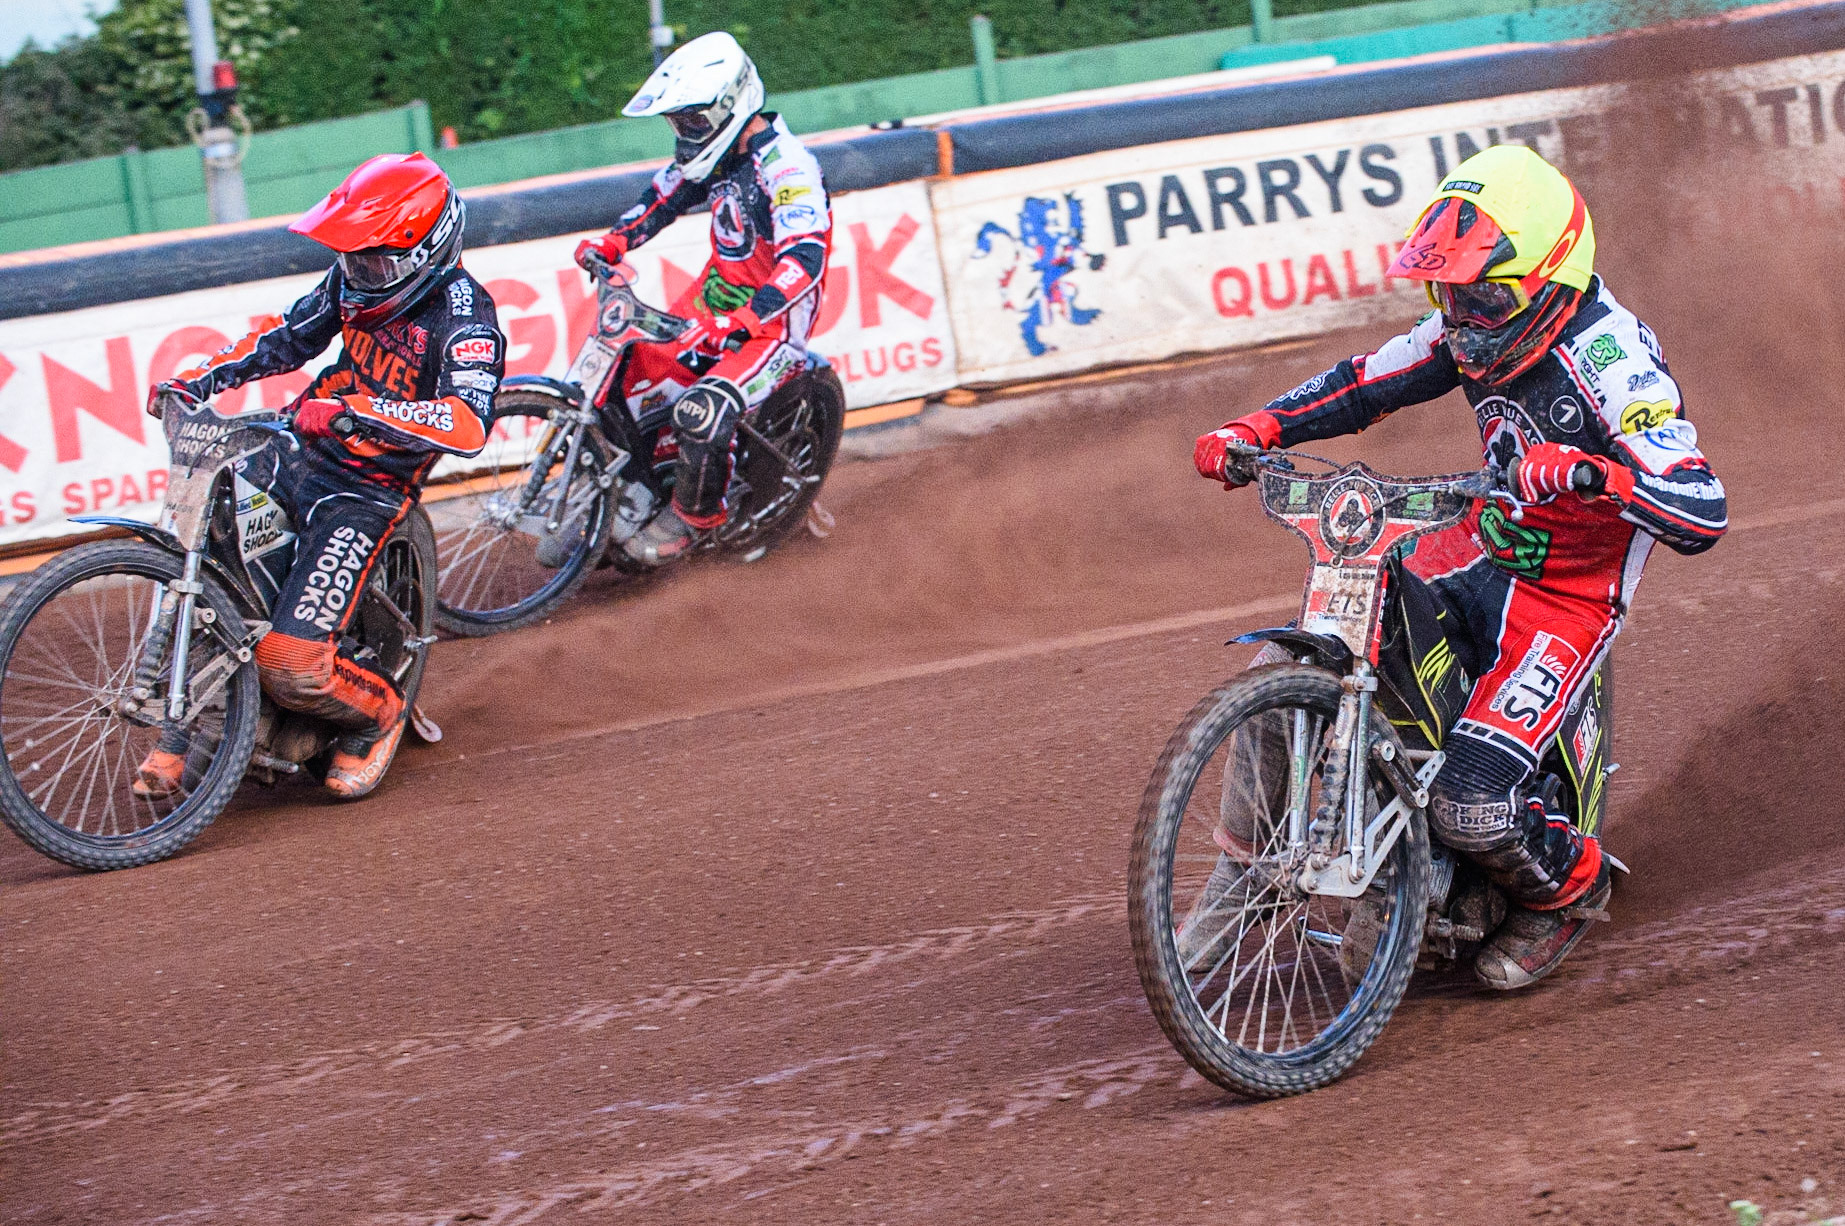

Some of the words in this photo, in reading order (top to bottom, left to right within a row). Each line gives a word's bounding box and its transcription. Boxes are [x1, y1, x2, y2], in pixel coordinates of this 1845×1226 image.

[1105, 143, 1404, 247] PARRYS
[1211, 241, 1421, 318] QUALI
[455, 341, 494, 358] NGK
[372, 402, 455, 432] SHOCKS
[679, 401, 707, 421] ATPI
[1559, 404, 1577, 424] 7
[62, 469, 170, 515] SPAR
[243, 529, 284, 555] SHOC
[294, 525, 355, 622] SHOCKS
[313, 532, 375, 632] HAGON
[1533, 632, 1548, 649] Fire
[1514, 649, 1540, 680] Training
[1491, 676, 1520, 711] Services
[1503, 664, 1561, 730] FTS
